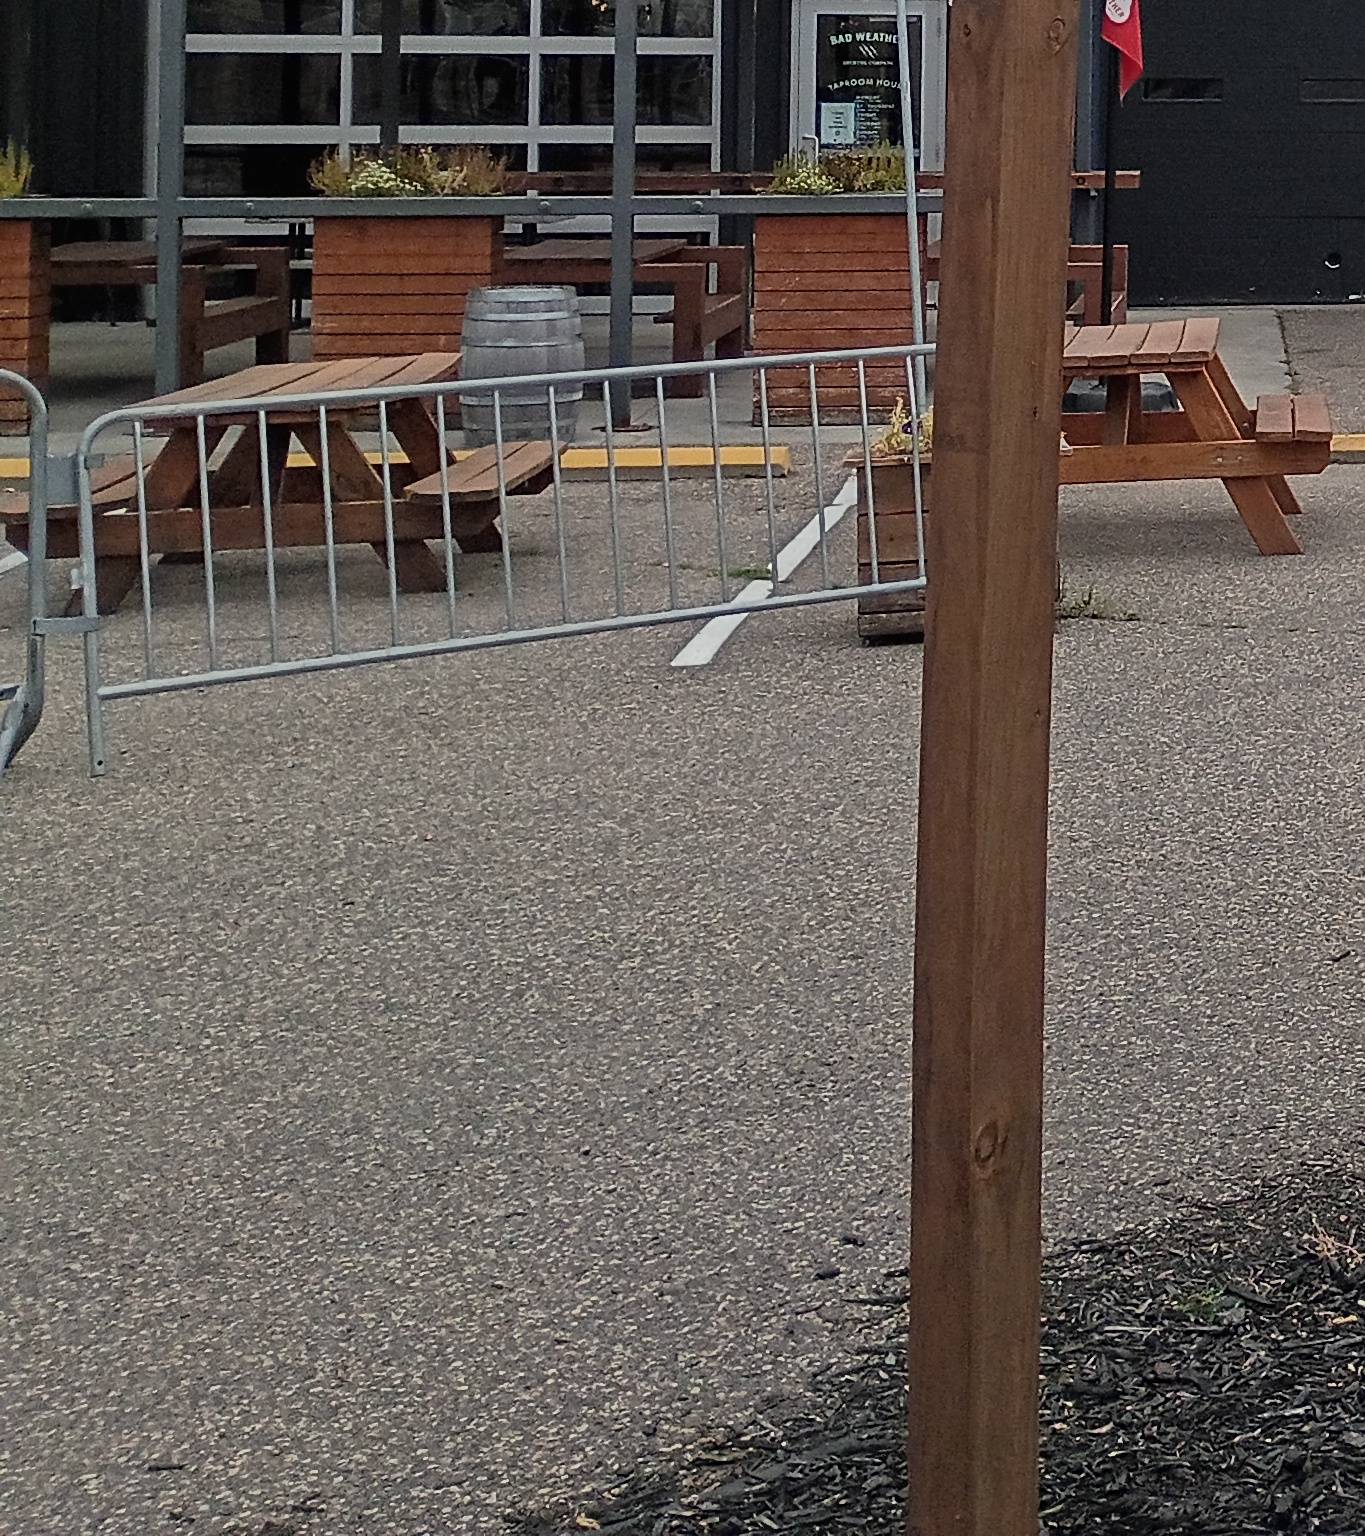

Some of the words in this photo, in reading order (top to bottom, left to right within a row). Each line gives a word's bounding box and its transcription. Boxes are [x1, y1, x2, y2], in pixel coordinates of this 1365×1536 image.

[829, 33, 853, 46] BAD
[855, 32, 898, 44] WEATHE
[827, 78, 874, 92] TAPROOM
